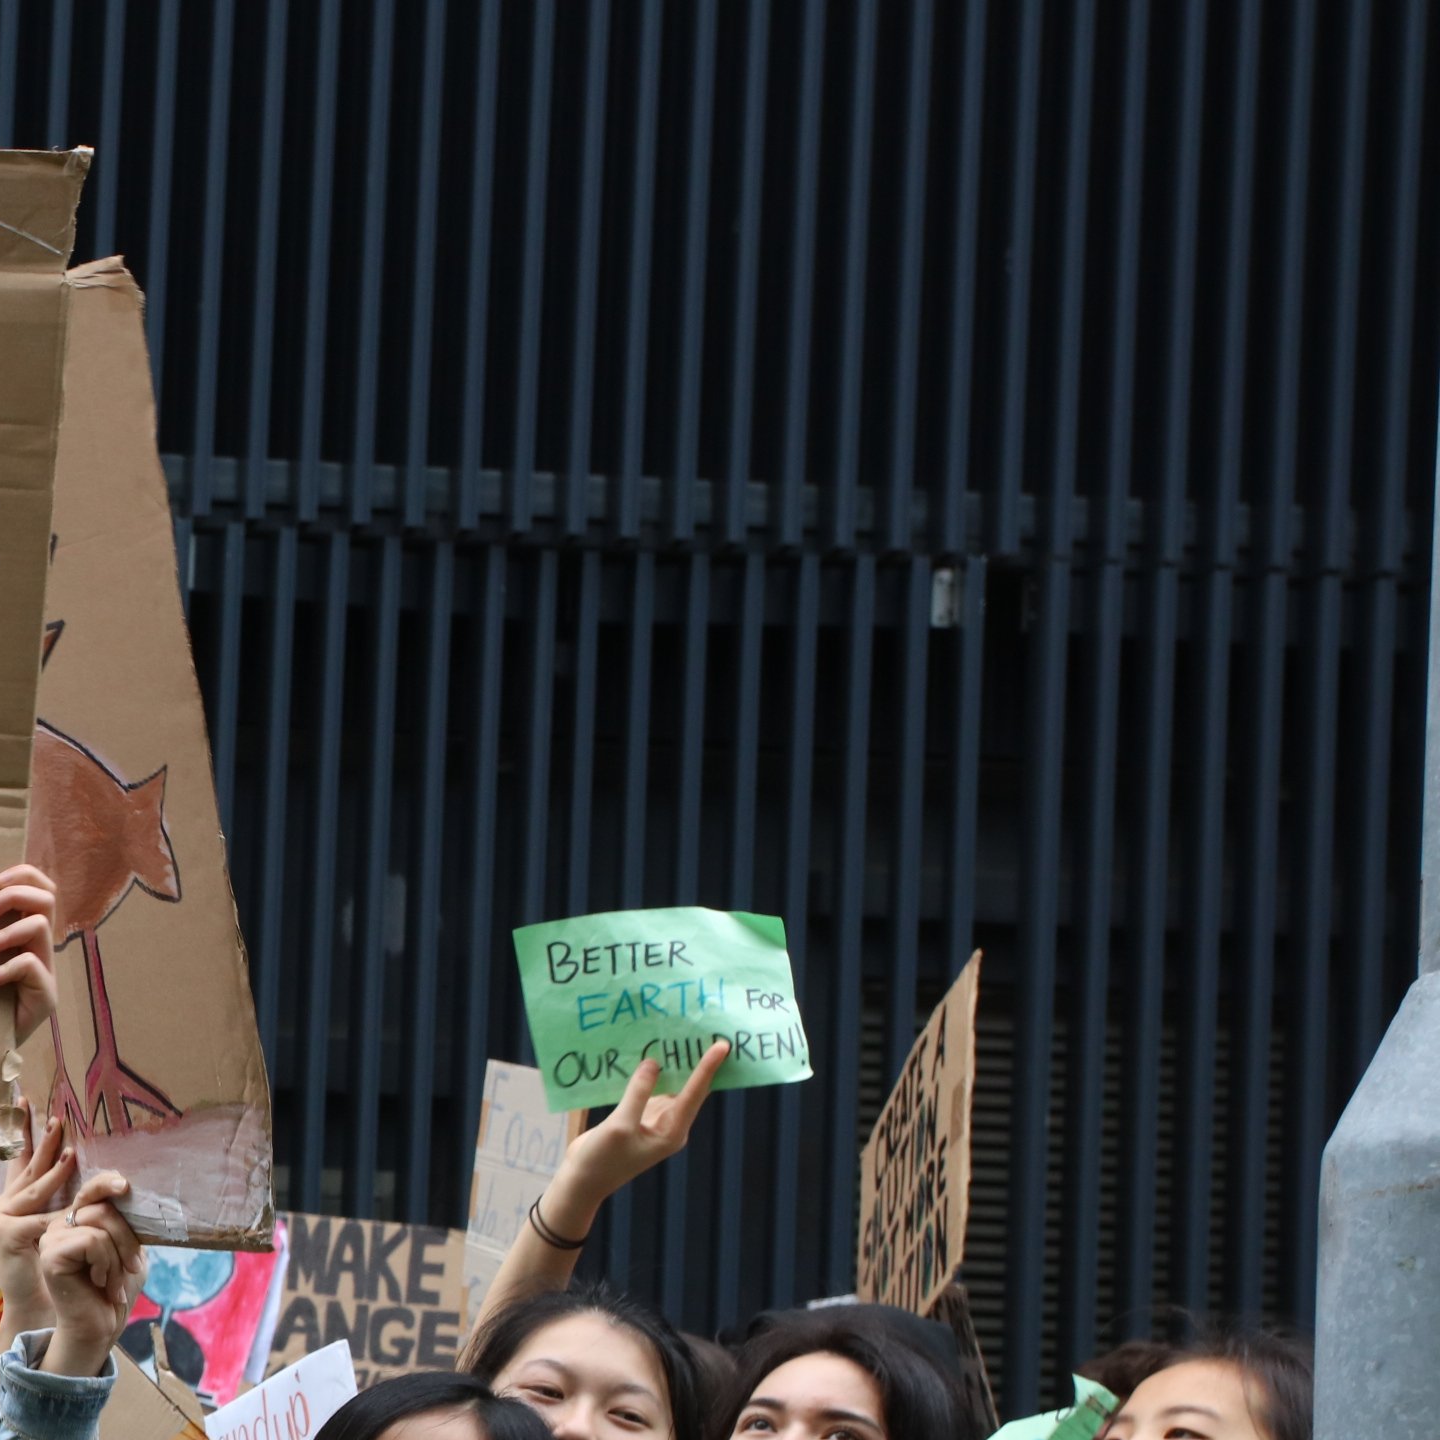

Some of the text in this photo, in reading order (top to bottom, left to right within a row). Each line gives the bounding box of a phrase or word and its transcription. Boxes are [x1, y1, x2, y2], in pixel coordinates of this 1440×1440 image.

[546, 940, 694, 985] BETTER
[577, 977, 790, 1031] EARTH FOR
[552, 1048, 630, 1089] OUR
[931, 1002, 947, 1081] A
[286, 1214, 450, 1306] MAKE
